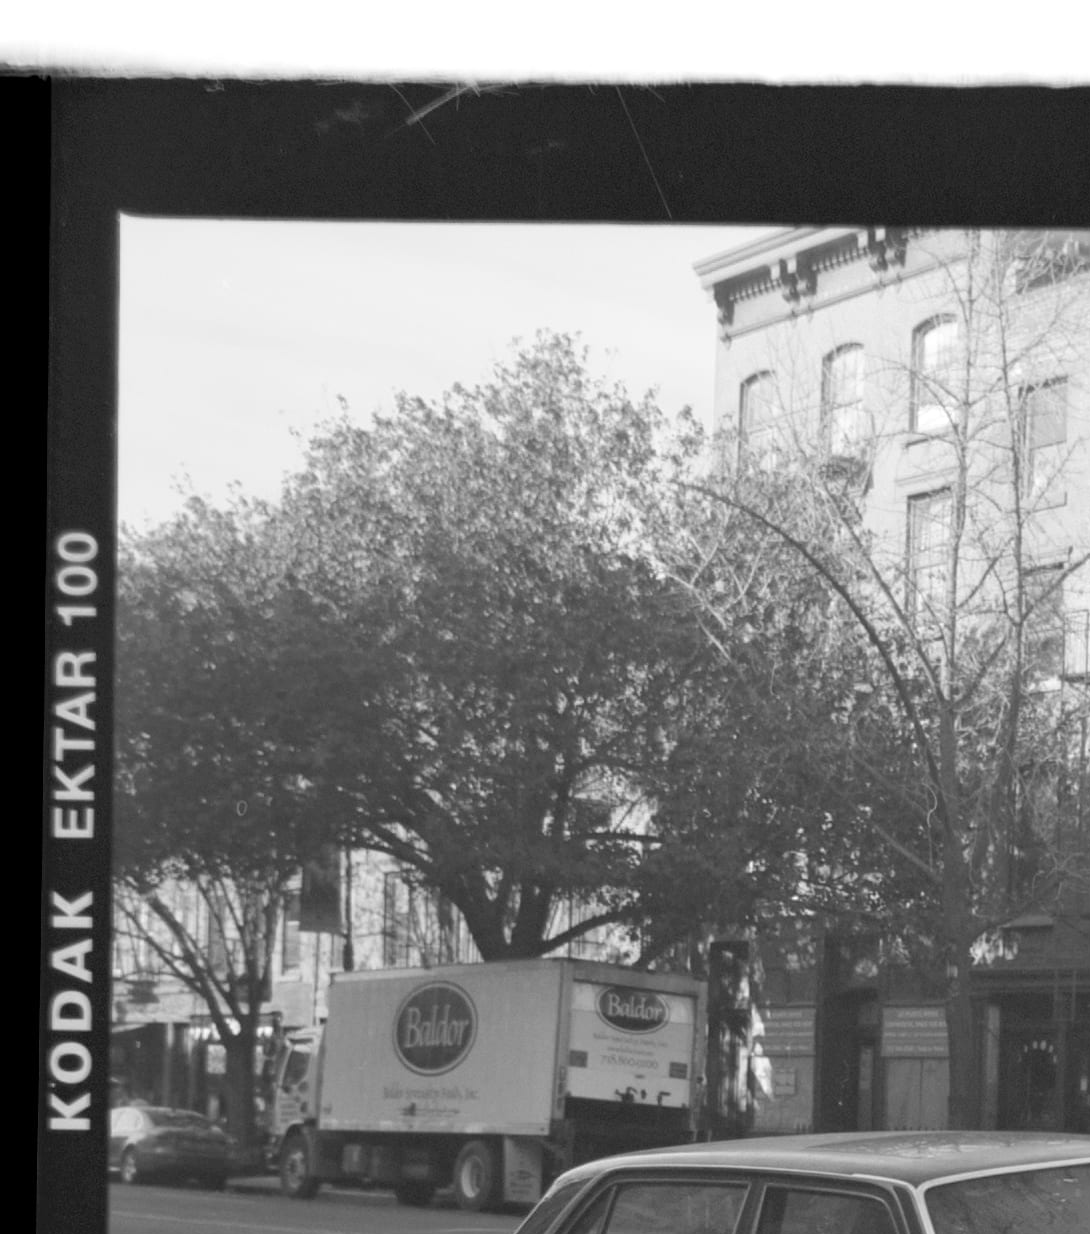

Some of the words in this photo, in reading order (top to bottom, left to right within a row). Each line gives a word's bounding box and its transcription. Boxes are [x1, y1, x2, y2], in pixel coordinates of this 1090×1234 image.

[55, 531, 98, 627] 100
[53, 651, 96, 839] EKTAR
[49, 891, 93, 1132] KODAK
[404, 1004, 470, 1049] Baldor
[607, 993, 663, 1020] Baldor
